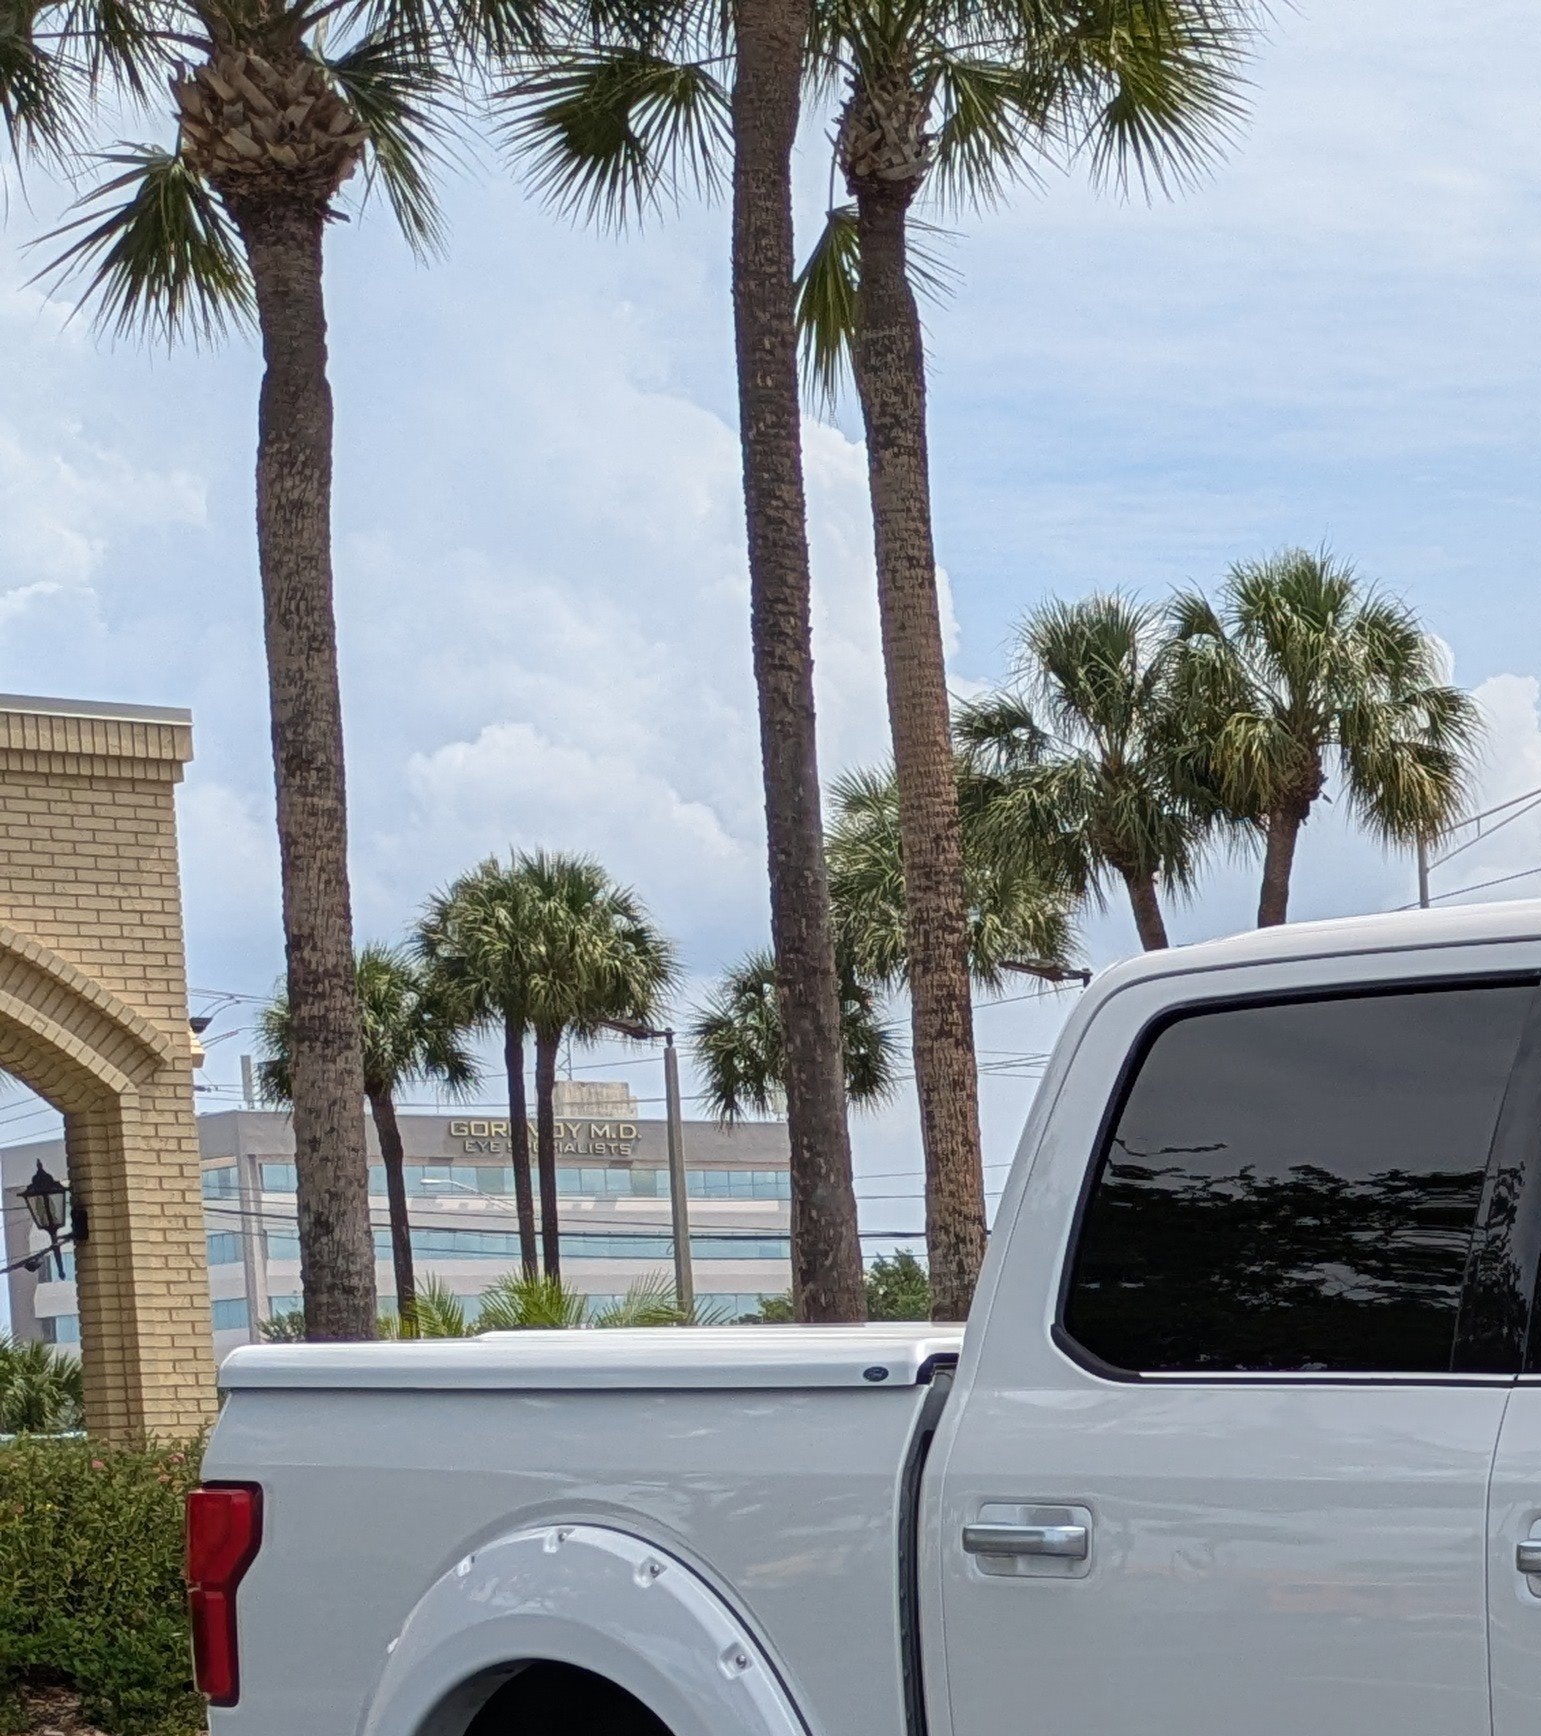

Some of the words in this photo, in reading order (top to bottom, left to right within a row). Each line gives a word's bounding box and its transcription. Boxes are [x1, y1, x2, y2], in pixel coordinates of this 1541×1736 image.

[450, 1120, 582, 1139] GOROY
[590, 1123, 642, 1140] M.D.
[464, 1140, 500, 1154] EYE
[507, 1141, 631, 1156] IALISTS
